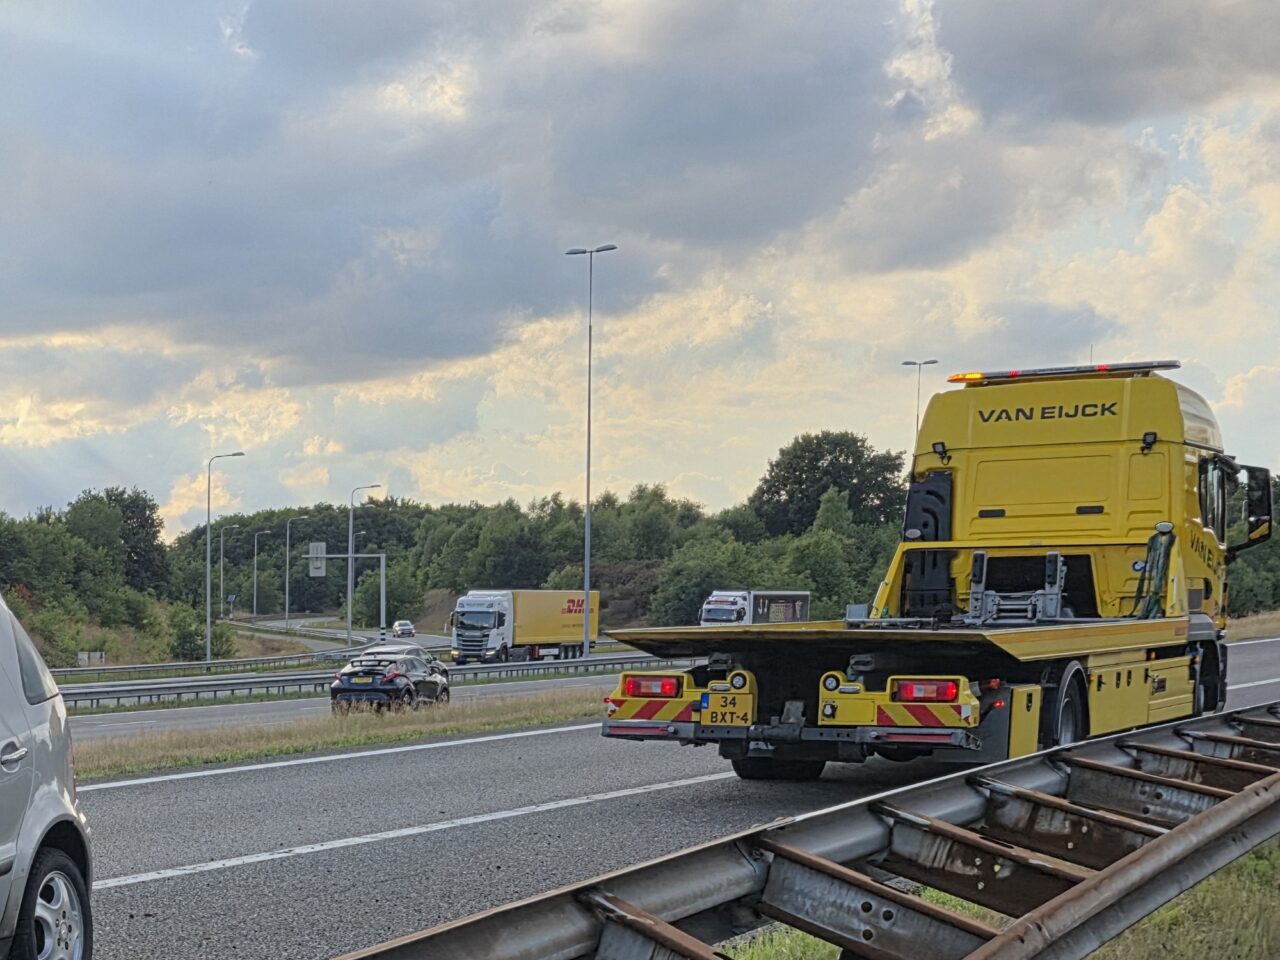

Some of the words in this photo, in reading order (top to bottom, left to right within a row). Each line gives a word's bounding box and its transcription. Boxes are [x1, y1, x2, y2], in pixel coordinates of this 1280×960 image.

[978, 407, 1035, 423] VAN
[1040, 402, 1118, 420] EIJCK
[566, 598, 589, 614] DH
[720, 696, 737, 708] 34
[710, 711, 749, 724] BXT-4
